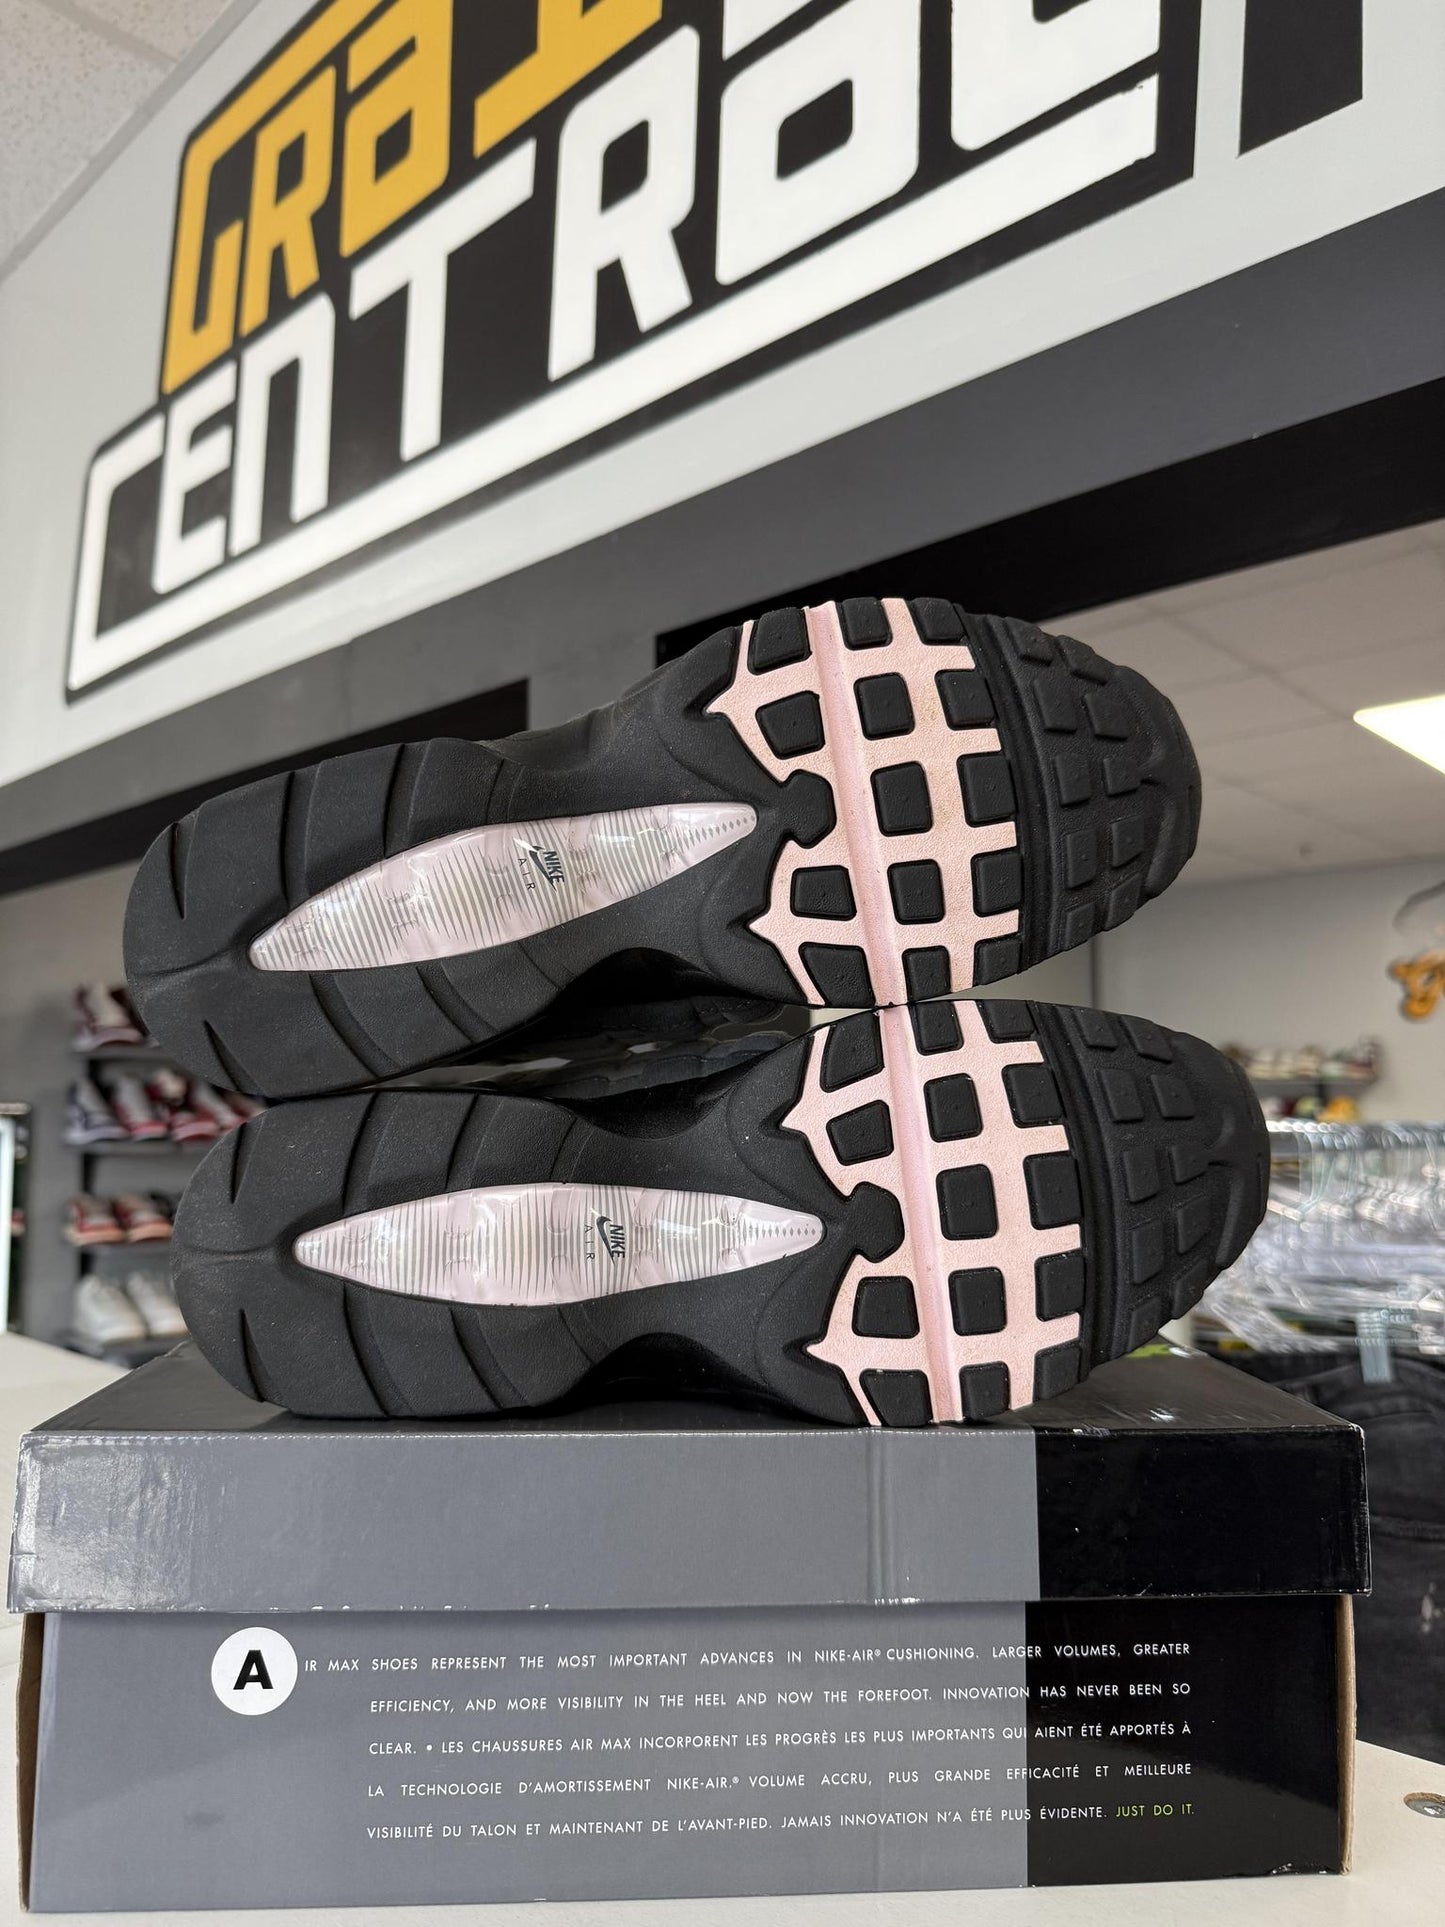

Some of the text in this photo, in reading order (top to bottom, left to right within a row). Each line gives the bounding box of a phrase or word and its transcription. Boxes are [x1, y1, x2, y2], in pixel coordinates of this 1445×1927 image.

[517, 857, 537, 891] AIR
[542, 850, 566, 884] NIKE
[584, 1223, 597, 1264] AIR
[608, 1223, 627, 1260] NIKE
[232, 1649, 274, 1691] A
[304, 1659, 318, 1672] IR
[327, 1658, 360, 1672] MAX
[371, 1657, 418, 1671] SHOES
[431, 1656, 507, 1671] REPRESENT
[519, 1655, 545, 1669] THE
[556, 1654, 597, 1669] MOST
[609, 1652, 688, 1668] IMPORTANT
[699, 1650, 774, 1665] ADVANCES
[787, 1650, 802, 1664] IN
[886, 1646, 979, 1661] CUSHIONING.
[992, 1645, 1043, 1659] LARGER
[1053, 1643, 1121, 1659] VOLUMES,
[1132, 1642, 1191, 1657] GREATER
[370, 1682, 1192, 1714] EFFICIENCY, AND MORE VISIBILITY IN THE HEEL AND NOW THE FOREFOOT. INNOVATION HAS NEVER BEEN SO
[368, 1720, 1192, 1755] CLEAR. LES CHAUSSURES AIR MAX INCORPORENT LES PROGRÈS LES PLUS IMPORTANTS QUI AIENT ÉTÉ APPORTÉS À
[368, 1784, 385, 1797] LA
[400, 1782, 503, 1797] TECHNOLOGIE
[748, 1774, 805, 1788] VOLUME
[820, 1771, 872, 1787] ACCRU,
[888, 1770, 919, 1784] PLUS
[934, 1768, 991, 1782] GRANDE
[1006, 1763, 1080, 1780] EFFICACITÉ
[1095, 1765, 1110, 1778] ET
[1124, 1762, 1192, 1777] MEILLEURE
[366, 1822, 434, 1839] VISIBILITÉ
[442, 1825, 462, 1838] DU
[470, 1823, 517, 1837] TALON
[525, 1823, 541, 1836] ET
[548, 1820, 644, 1836] MAINTENANT
[651, 1819, 670, 1833] DE
[780, 1814, 832, 1829] JAMAIS
[840, 1811, 929, 1827] INNOVATION
[970, 1807, 993, 1822] ÉTÉ
[1000, 1808, 1032, 1821] PLUS
[1039, 1805, 1108, 1820] ÉVIDENTE.
[1115, 1804, 1146, 1818] JUST
[1153, 1803, 1174, 1817] DO
[1181, 1803, 1196, 1816] IT.
